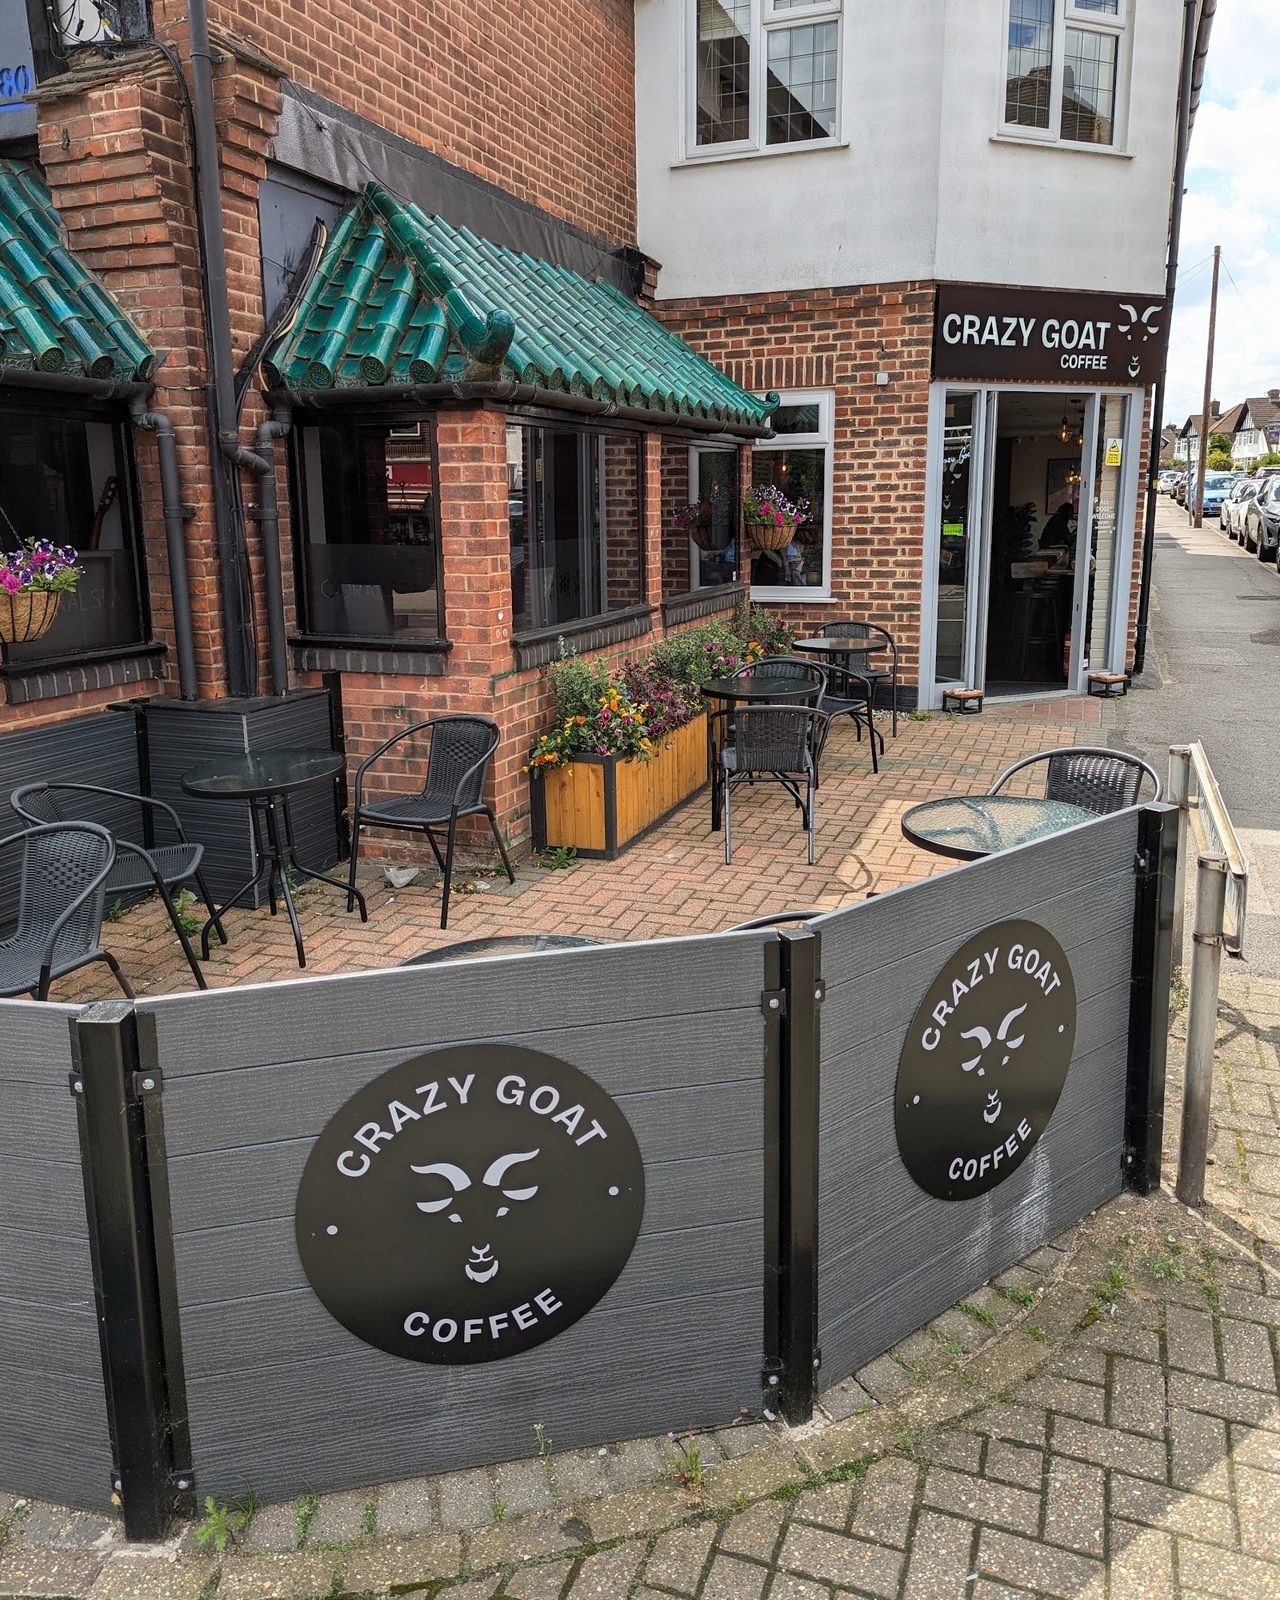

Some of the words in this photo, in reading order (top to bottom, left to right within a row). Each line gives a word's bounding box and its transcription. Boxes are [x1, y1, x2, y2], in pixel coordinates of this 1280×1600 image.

[942, 313, 1037, 347] CRAZY
[1041, 318, 1112, 350] GOAT
[1060, 353, 1108, 370] COFFEE
[921, 947, 1000, 1051] CRAZY
[1006, 943, 1063, 997] GOAT
[336, 1073, 476, 1178] CRAZY
[496, 1074, 608, 1148] GOAT
[947, 1117, 1033, 1183] COFFEE
[403, 1287, 564, 1343] COFFEE
